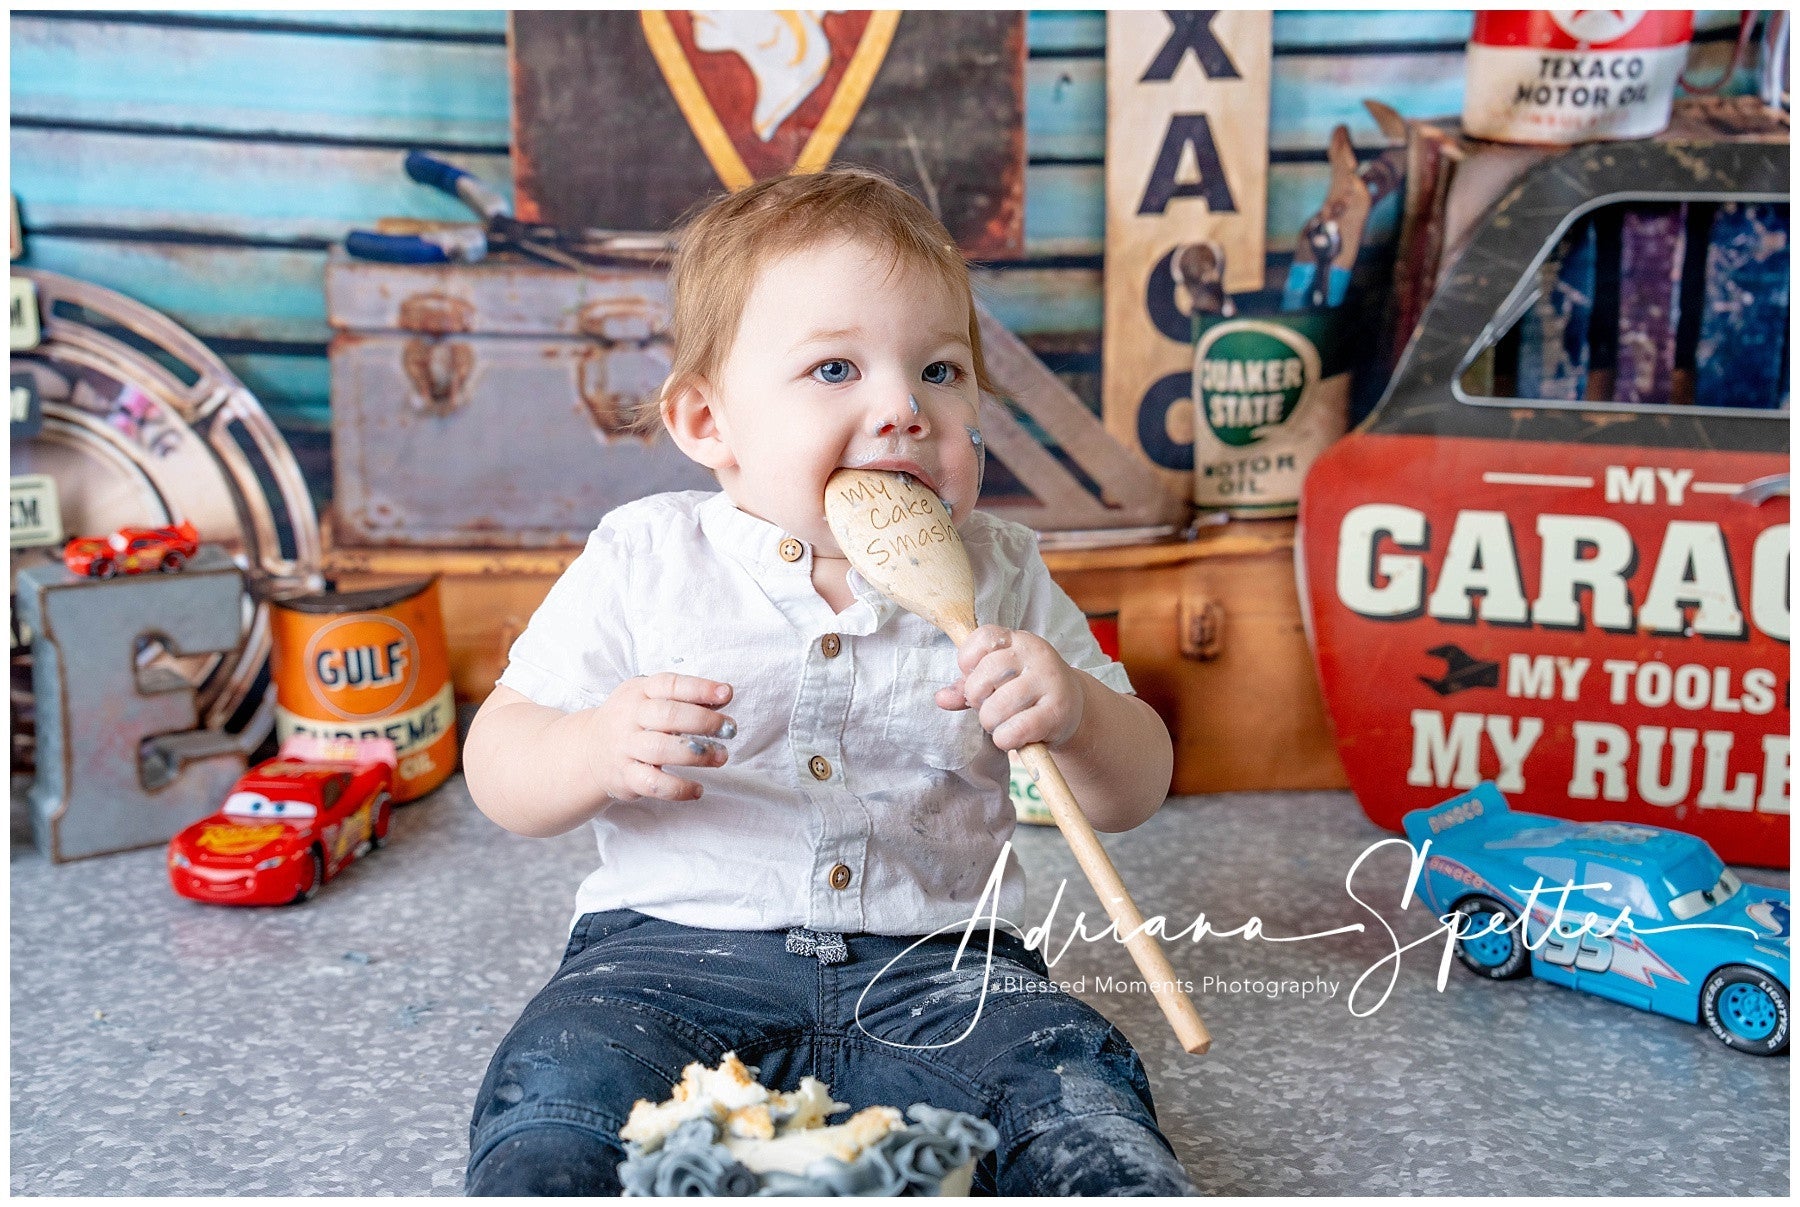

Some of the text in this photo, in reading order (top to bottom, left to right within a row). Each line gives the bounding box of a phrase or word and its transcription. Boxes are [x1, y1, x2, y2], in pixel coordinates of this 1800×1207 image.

[1538, 57, 1643, 80] TEXACO
[1514, 84, 1608, 107] MOTOR
[1202, 358, 1302, 393] QUAKER
[1209, 393, 1285, 428] STATE
[1605, 466, 1694, 505] MY
[317, 637, 409, 691] GULF
[1506, 653, 1777, 715] MY TOOLS
[1406, 708, 1544, 795] MY
